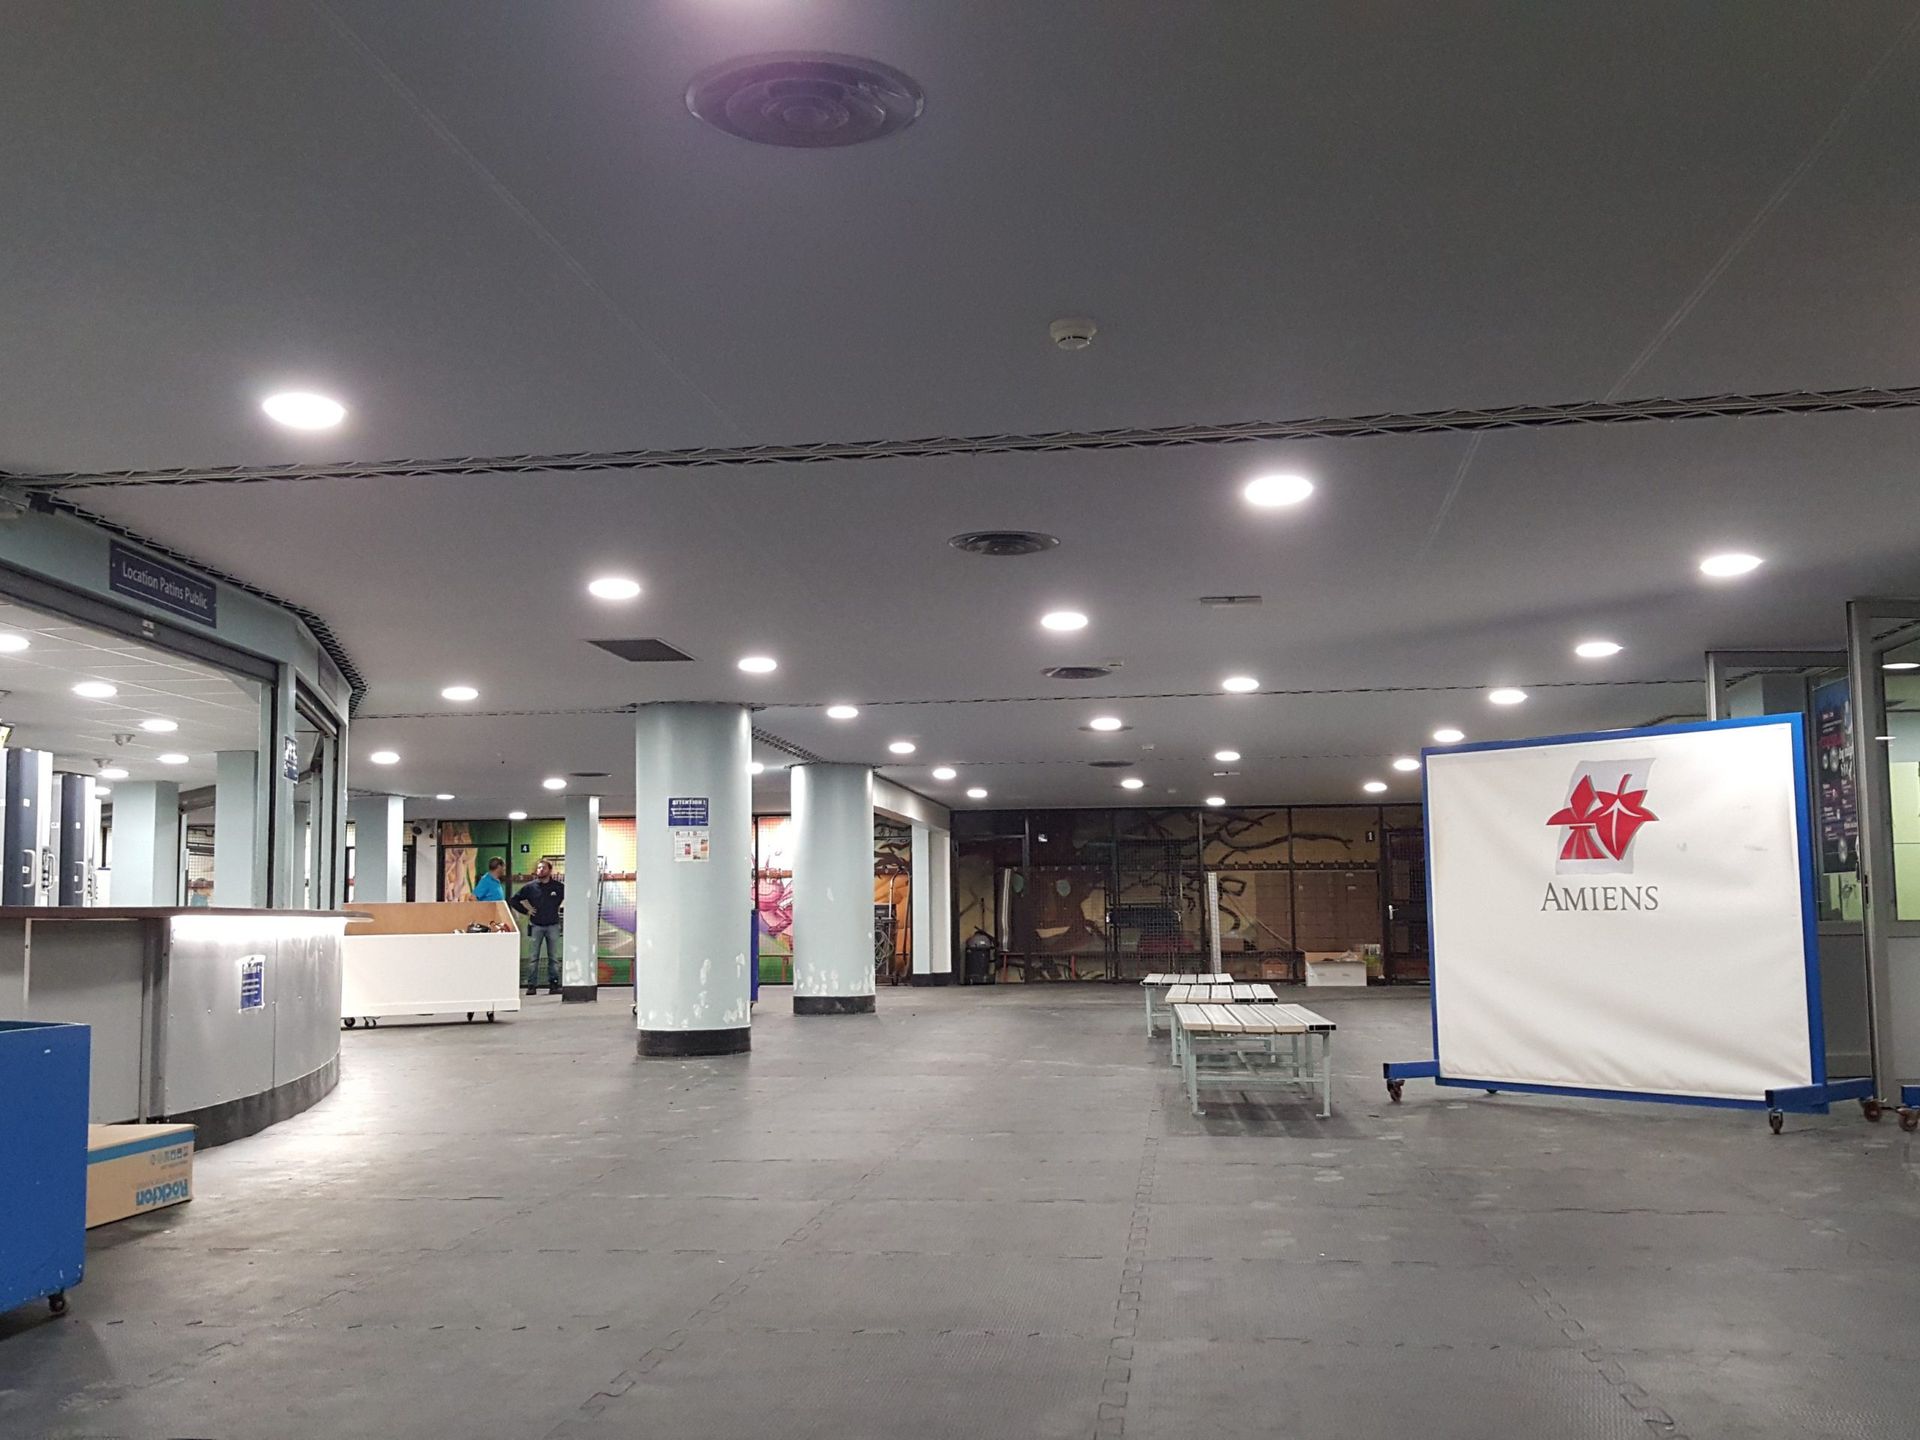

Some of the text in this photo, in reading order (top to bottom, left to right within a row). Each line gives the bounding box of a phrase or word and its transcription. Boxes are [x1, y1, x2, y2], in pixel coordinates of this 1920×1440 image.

[123, 562, 208, 610] Location Patins Public
[1367, 831, 1373, 841] 1
[1540, 882, 1659, 911] AMIENS
